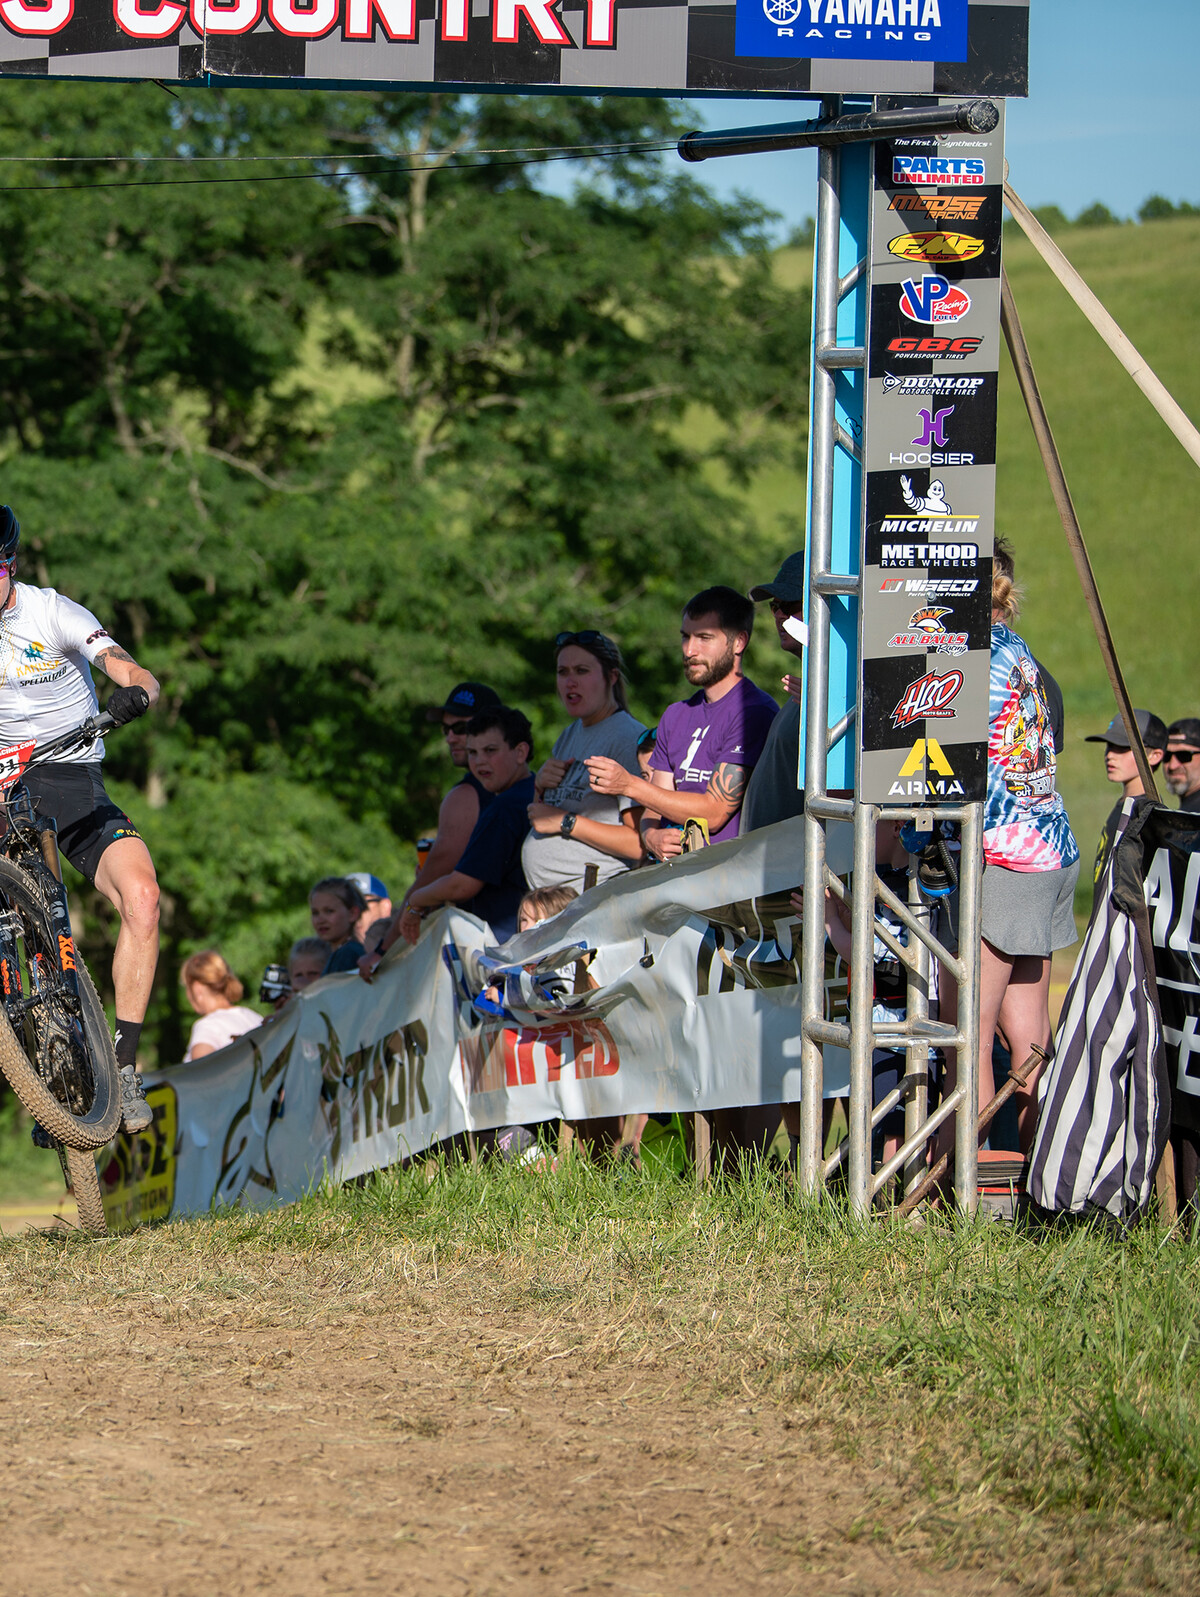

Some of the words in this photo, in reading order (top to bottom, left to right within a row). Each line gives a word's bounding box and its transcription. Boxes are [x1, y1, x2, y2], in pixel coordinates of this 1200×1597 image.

[809, 0, 942, 27] YAMAHA
[777, 28, 932, 42] RACING
[894, 138, 910, 146] The
[911, 139, 933, 147] First
[893, 157, 985, 174] PARTS
[893, 173, 985, 184] UNLIMITED
[887, 195, 988, 211] MOOSE
[925, 210, 979, 220] RACING
[889, 235, 985, 255] FMF
[900, 274, 950, 322] VP
[933, 299, 972, 314] Racing
[886, 337, 982, 353] GBC
[901, 377, 985, 389] DUNLOP
[898, 387, 953, 396] MOTORCYCLE
[953, 388, 977, 396] TIRES
[889, 452, 974, 465] HOOSIER
[880, 520, 978, 533] MICHELIN
[881, 544, 978, 560] METHOD
[881, 559, 915, 567] RACE
[922, 559, 977, 567] WHEELS
[889, 633, 918, 646] ALL
[920, 632, 968, 645] BALLS
[936, 644, 968, 656] Racing
[19, 665, 67, 687] SPECIALIZED
[1004, 770, 1027, 781] 2022
[887, 780, 965, 796] ARMA
[1015, 788, 1032, 797] OUT
[58, 934, 77, 972] FOX
